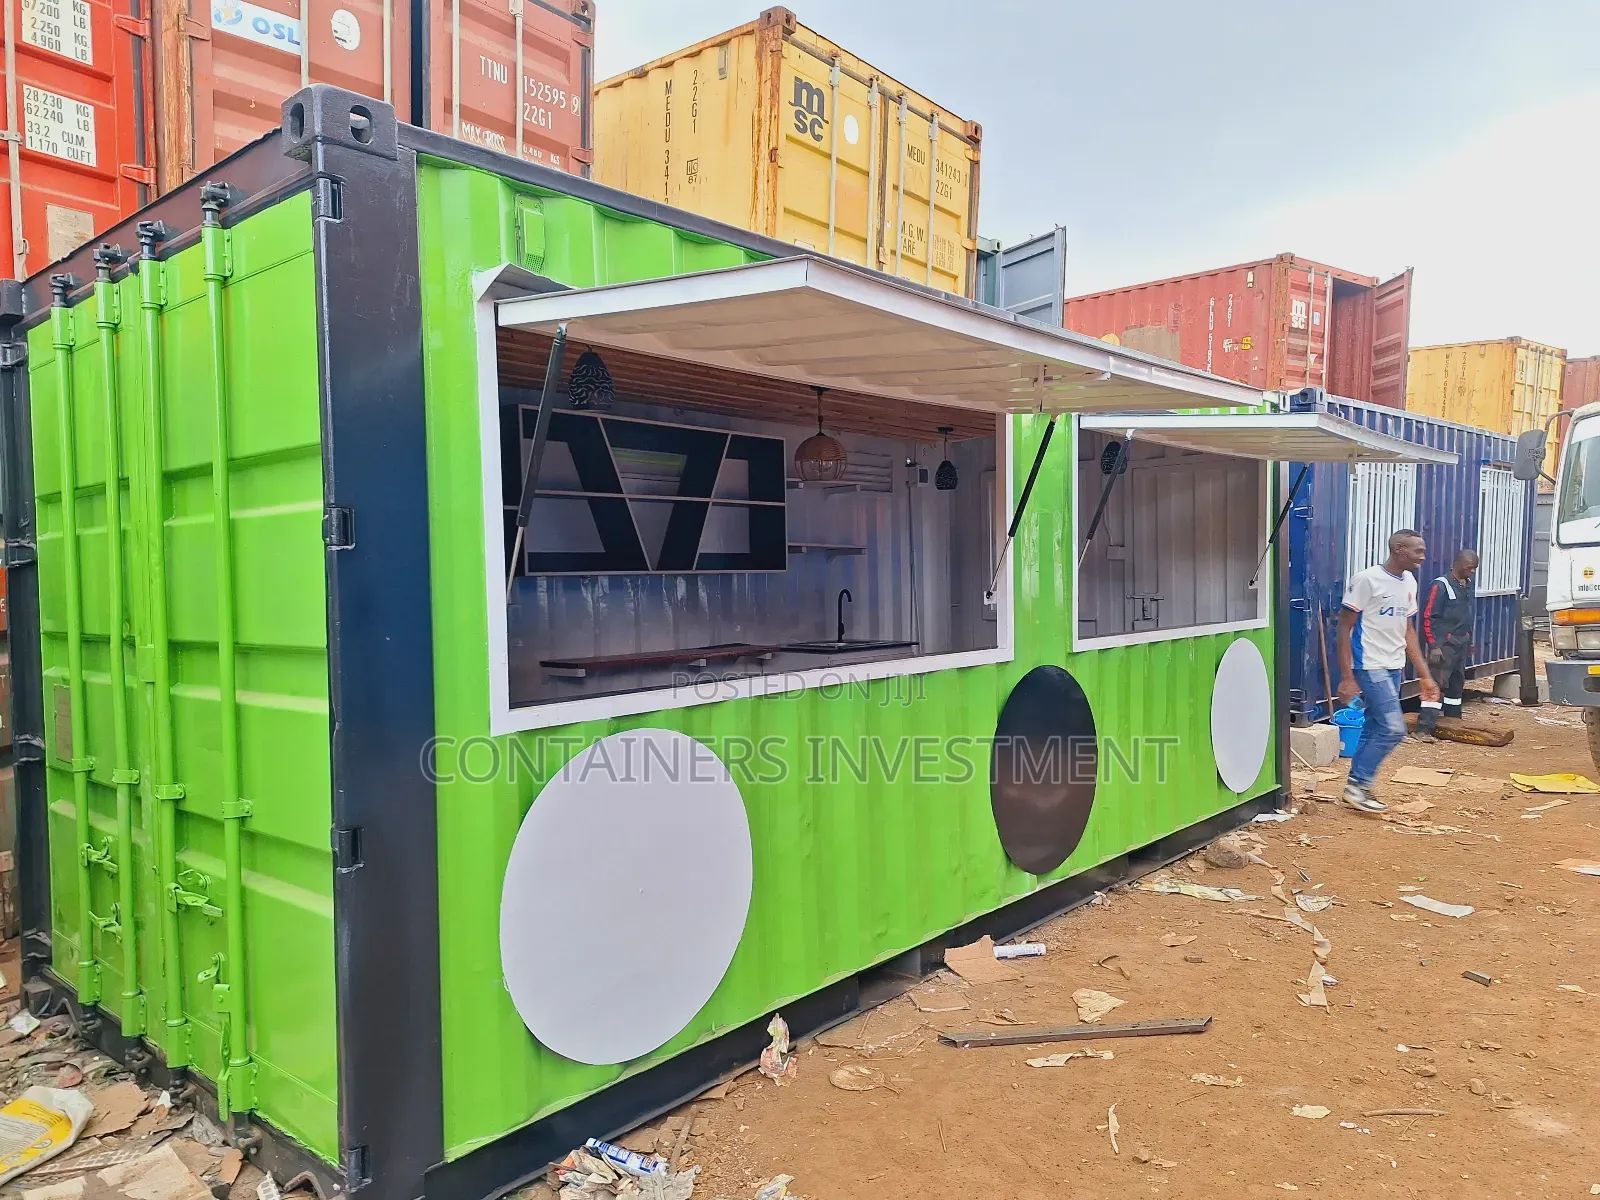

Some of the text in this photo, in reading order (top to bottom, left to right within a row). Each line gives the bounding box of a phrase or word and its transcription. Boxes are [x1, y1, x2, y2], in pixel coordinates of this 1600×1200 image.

[31, 17, 90, 48] 2.250 KG.
[73, 15, 89, 31] LB.
[31, 32, 90, 62] 4.960 LB.
[480, 55, 580, 116] TTNU 152595 9
[26, 88, 92, 119] 28.230 KG.
[26, 103, 92, 133] 62.240 LB.
[523, 102, 552, 130] 22G1
[27, 121, 51, 138] 33.2
[29, 136, 58, 154] 1.170
[907, 143, 926, 165] MEDU
[935, 158, 961, 184] 341243
[935, 179, 953, 200] 22G1
[901, 236, 916, 256] ARE
